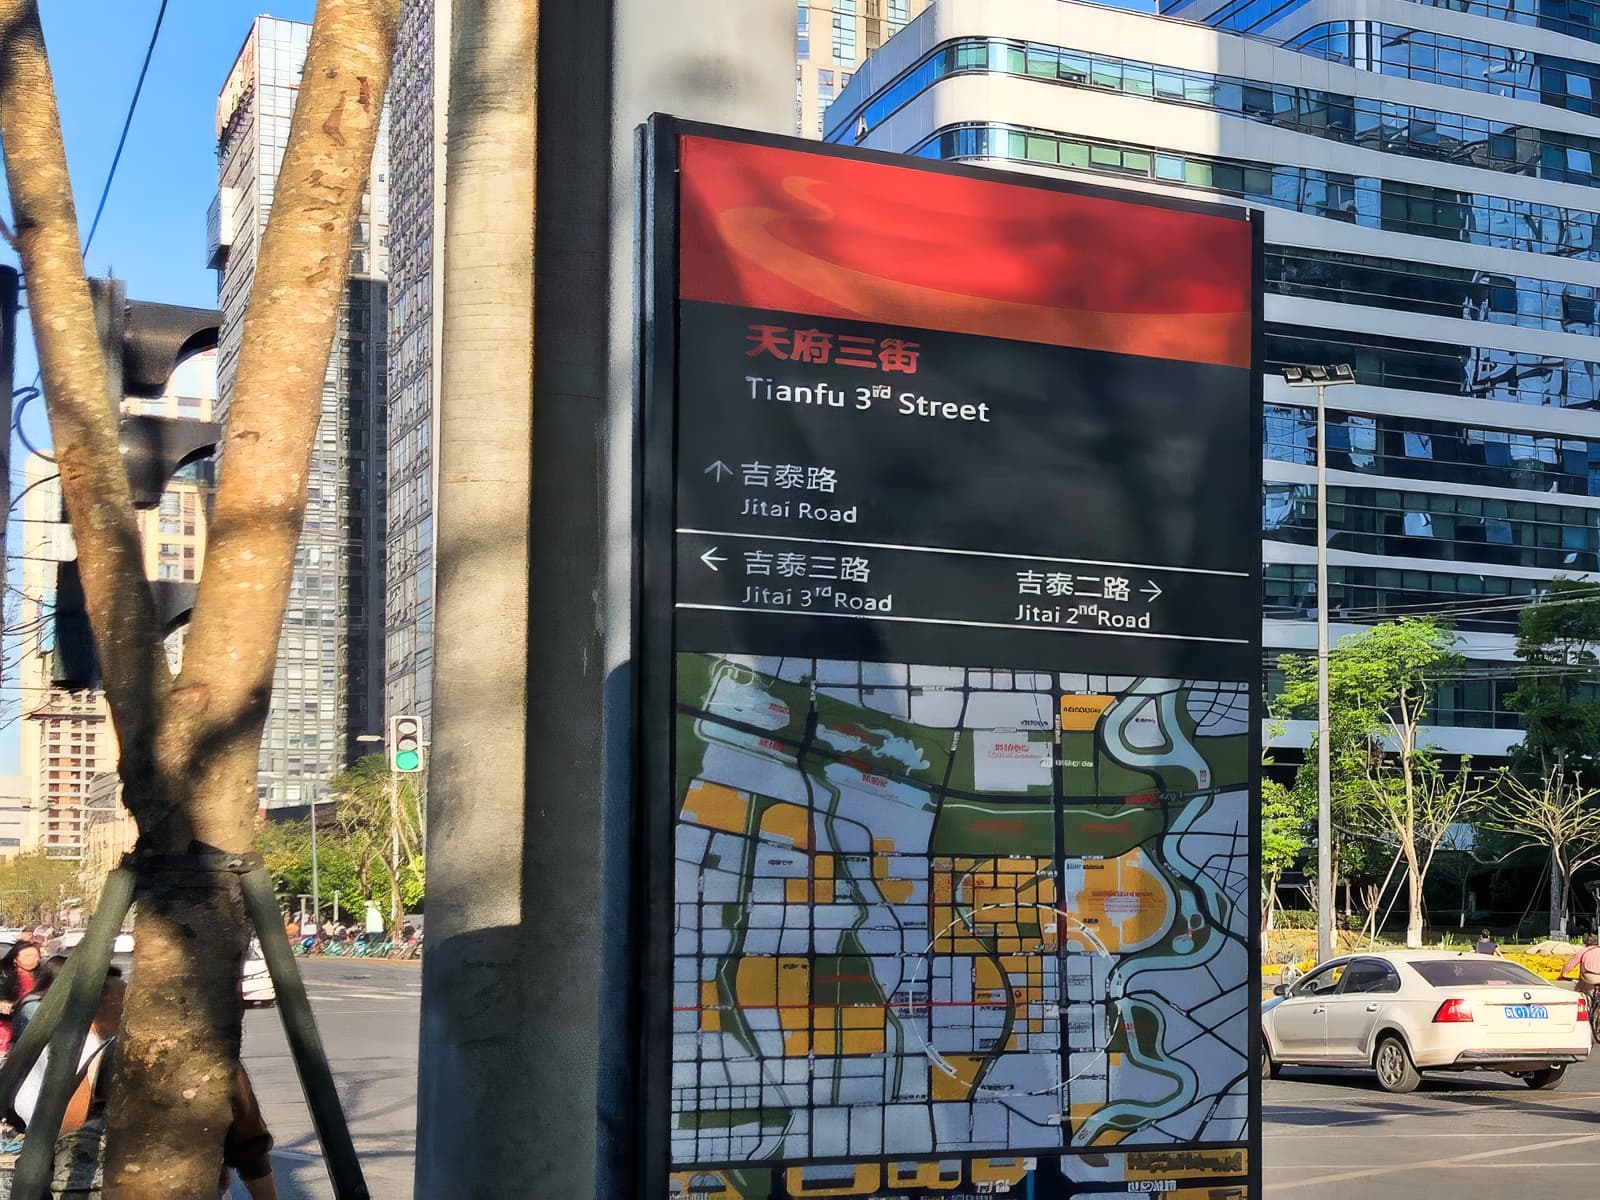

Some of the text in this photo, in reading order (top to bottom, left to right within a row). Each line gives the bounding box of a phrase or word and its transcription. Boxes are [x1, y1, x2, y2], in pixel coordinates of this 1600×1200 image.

[745, 323, 920, 375] 天府三街
[745, 376, 991, 423] Tianfu 3rd Street
[741, 461, 838, 493] 吉泰路
[741, 498, 858, 523] Jitai Road
[743, 550, 871, 583] 吉泰三路
[742, 586, 792, 605] Jitai
[834, 594, 892, 612] Road
[1016, 569, 1131, 601] 吉泰二路
[1015, 604, 1061, 623] Jitai
[1097, 609, 1150, 629] Road
